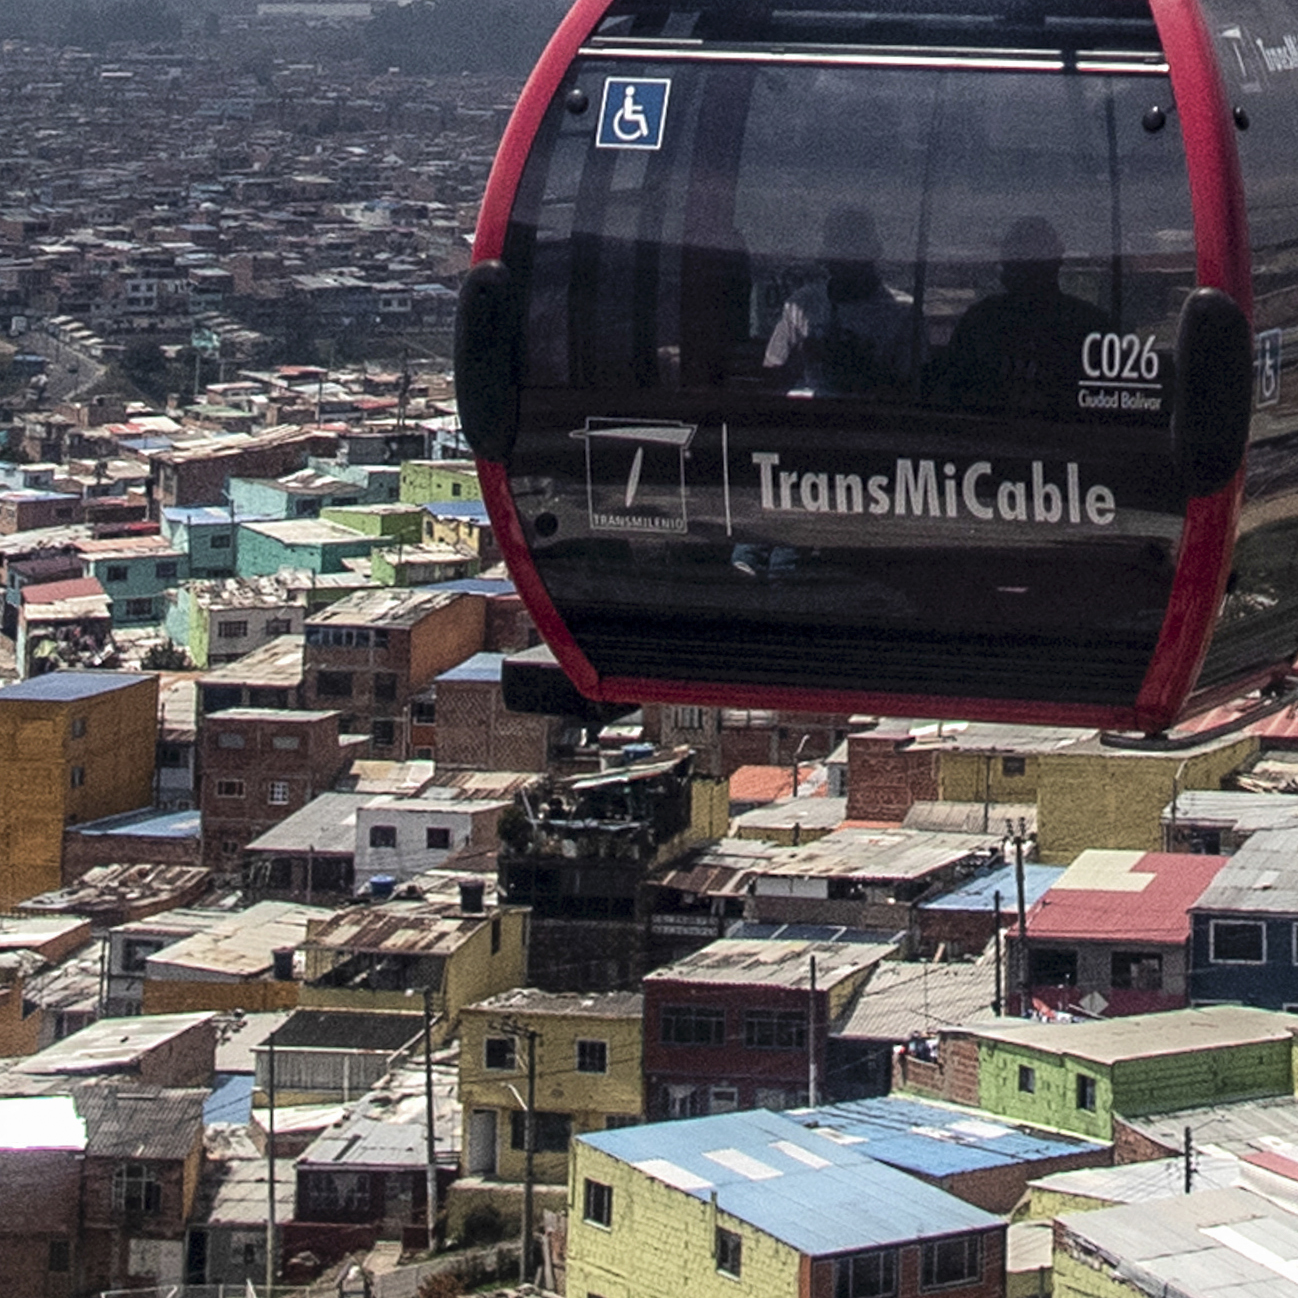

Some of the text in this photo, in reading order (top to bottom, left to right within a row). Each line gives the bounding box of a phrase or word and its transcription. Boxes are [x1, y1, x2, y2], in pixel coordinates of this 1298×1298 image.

[1082, 332, 1159, 379] C026
[752, 452, 1116, 525] TransMiCable
[593, 514, 684, 529] TRANSMILENIO
